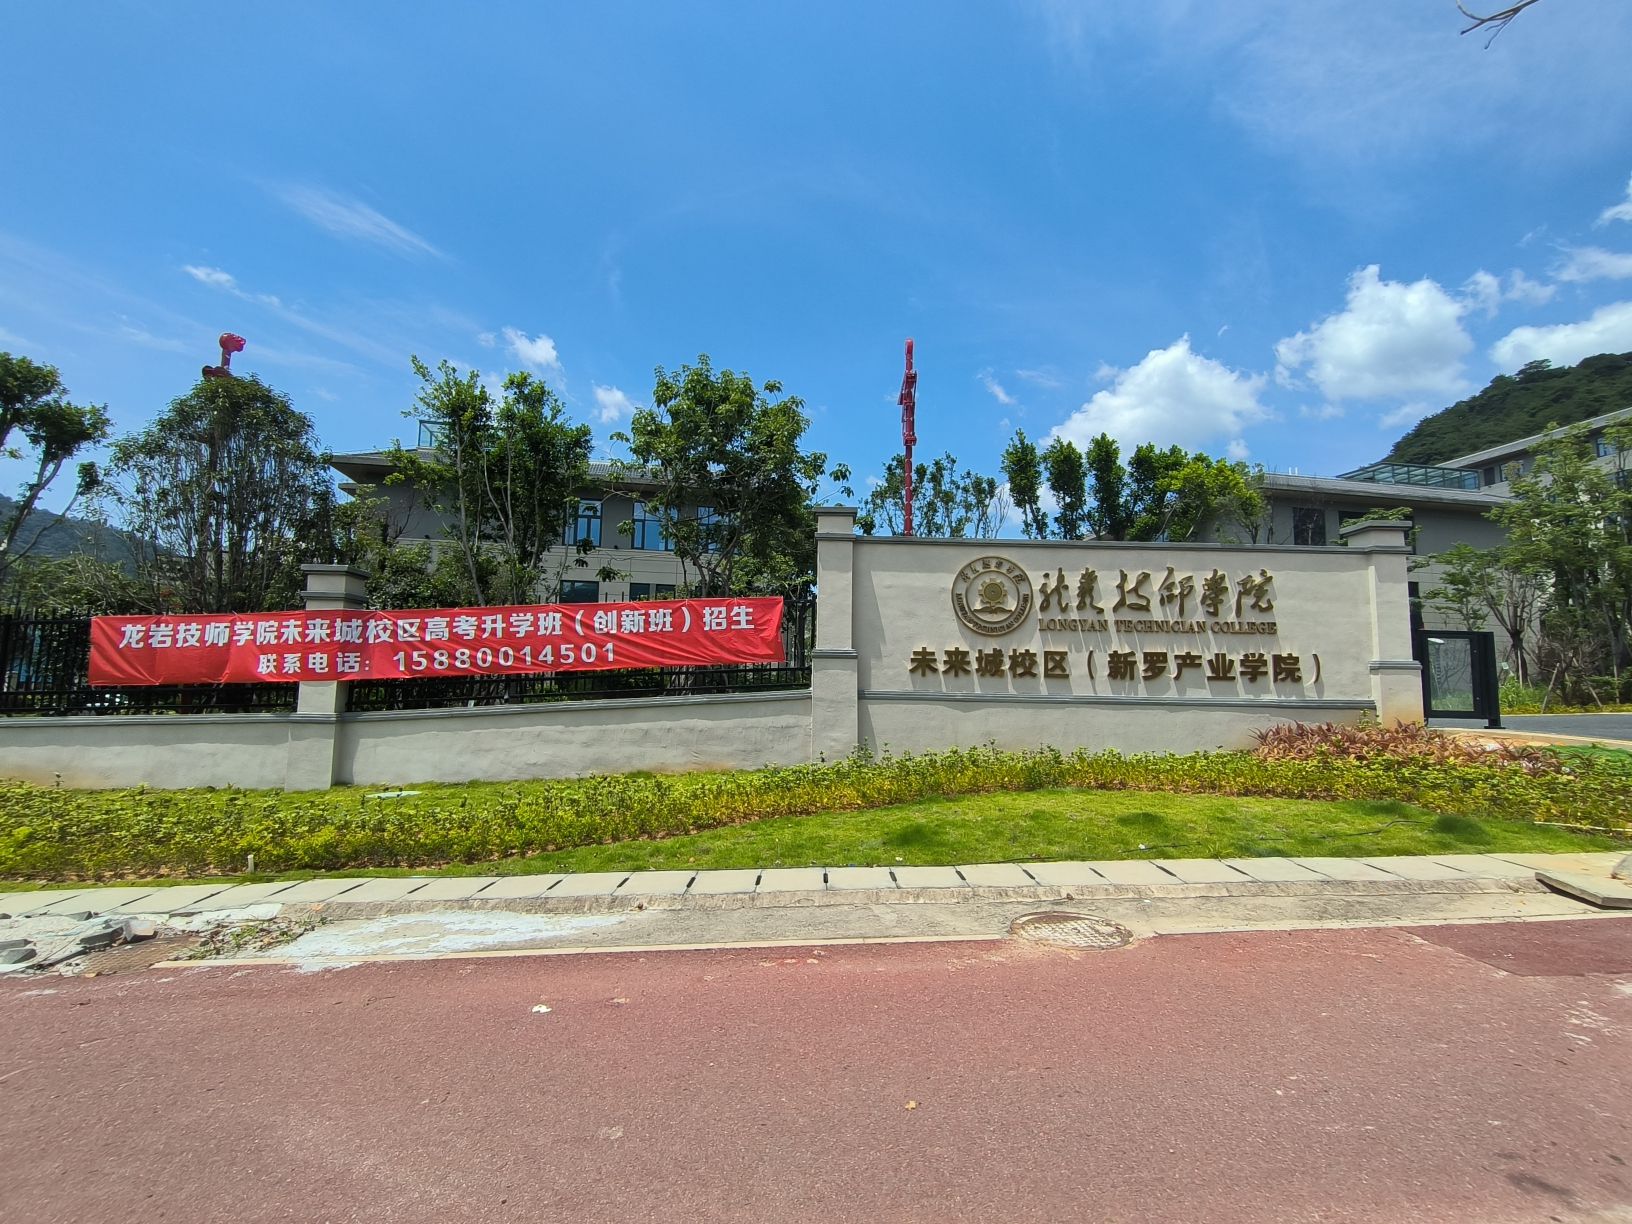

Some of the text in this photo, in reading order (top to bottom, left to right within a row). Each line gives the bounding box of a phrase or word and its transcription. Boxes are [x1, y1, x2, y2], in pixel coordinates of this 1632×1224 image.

[1038, 618, 1278, 635] LONGYAN TECHNICIAN COLLEGE
[393, 642, 616, 673] 15880014501
